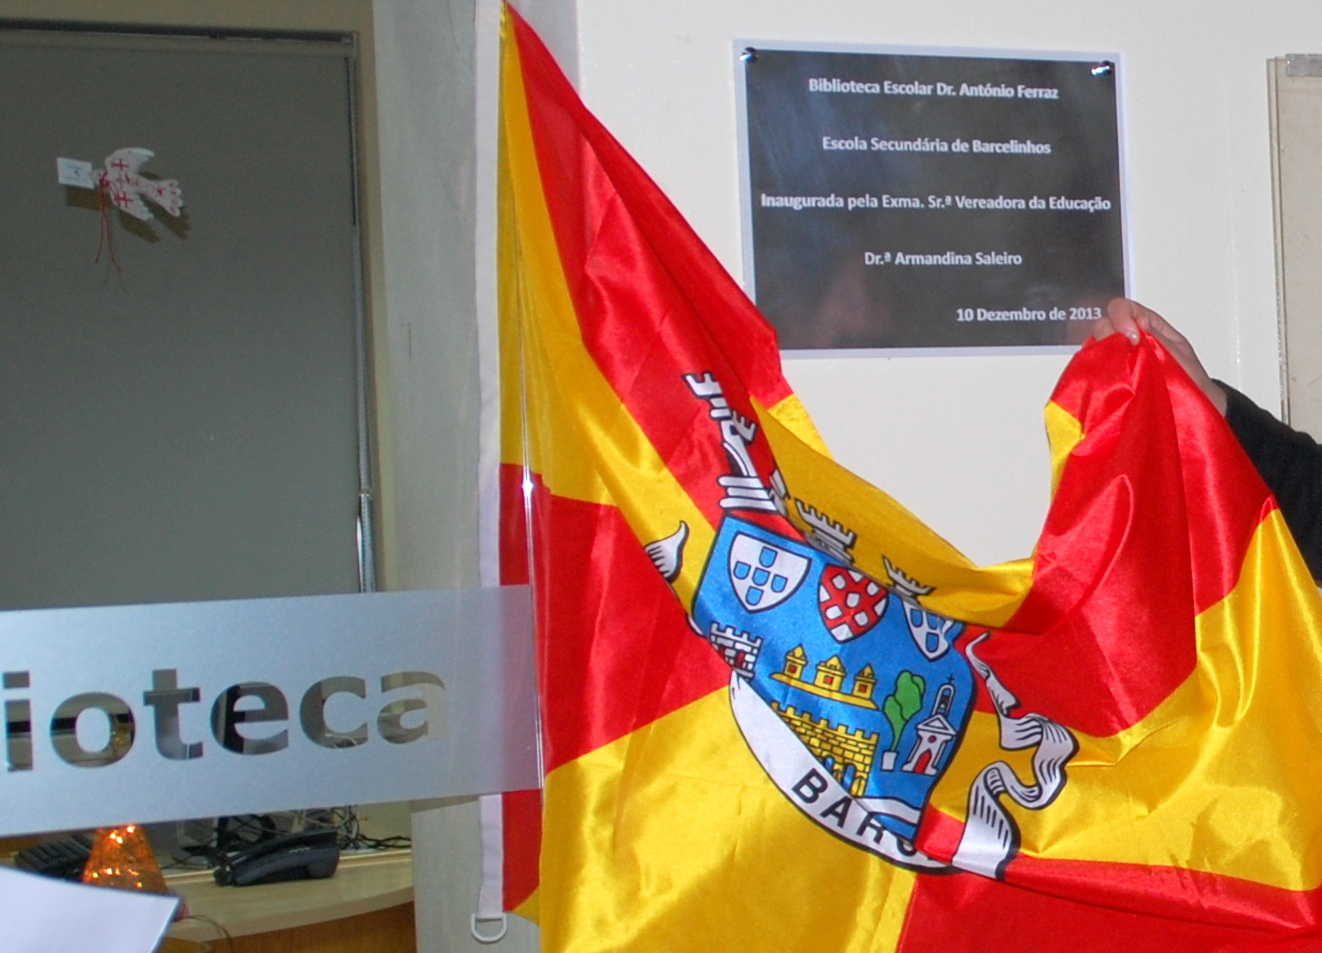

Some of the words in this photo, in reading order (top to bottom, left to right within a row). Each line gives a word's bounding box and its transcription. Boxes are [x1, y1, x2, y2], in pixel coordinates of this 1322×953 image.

[808, 78, 881, 94] Biblioteca
[883, 80, 933, 95] Escolar
[936, 82, 957, 97] Dr.
[959, 83, 1014, 98] António
[1017, 85, 1059, 99] Ferraz
[822, 136, 867, 151] Escola
[870, 137, 949, 152] Secundária
[951, 139, 970, 153] de
[972, 139, 1051, 154] Barcelinhos
[761, 193, 844, 211] Inaugurada
[847, 193, 879, 211] pela
[882, 194, 925, 209] Exma.
[955, 195, 1026, 210] Vereadora
[1028, 196, 1046, 210] da
[1049, 196, 1111, 213] Educação
[894, 250, 972, 266] Armandina
[975, 250, 1023, 266] Saleiro
[956, 308, 974, 322] 10
[976, 308, 1046, 321] Dezembro
[1048, 307, 1067, 321] de
[1069, 307, 1102, 320] 2013
